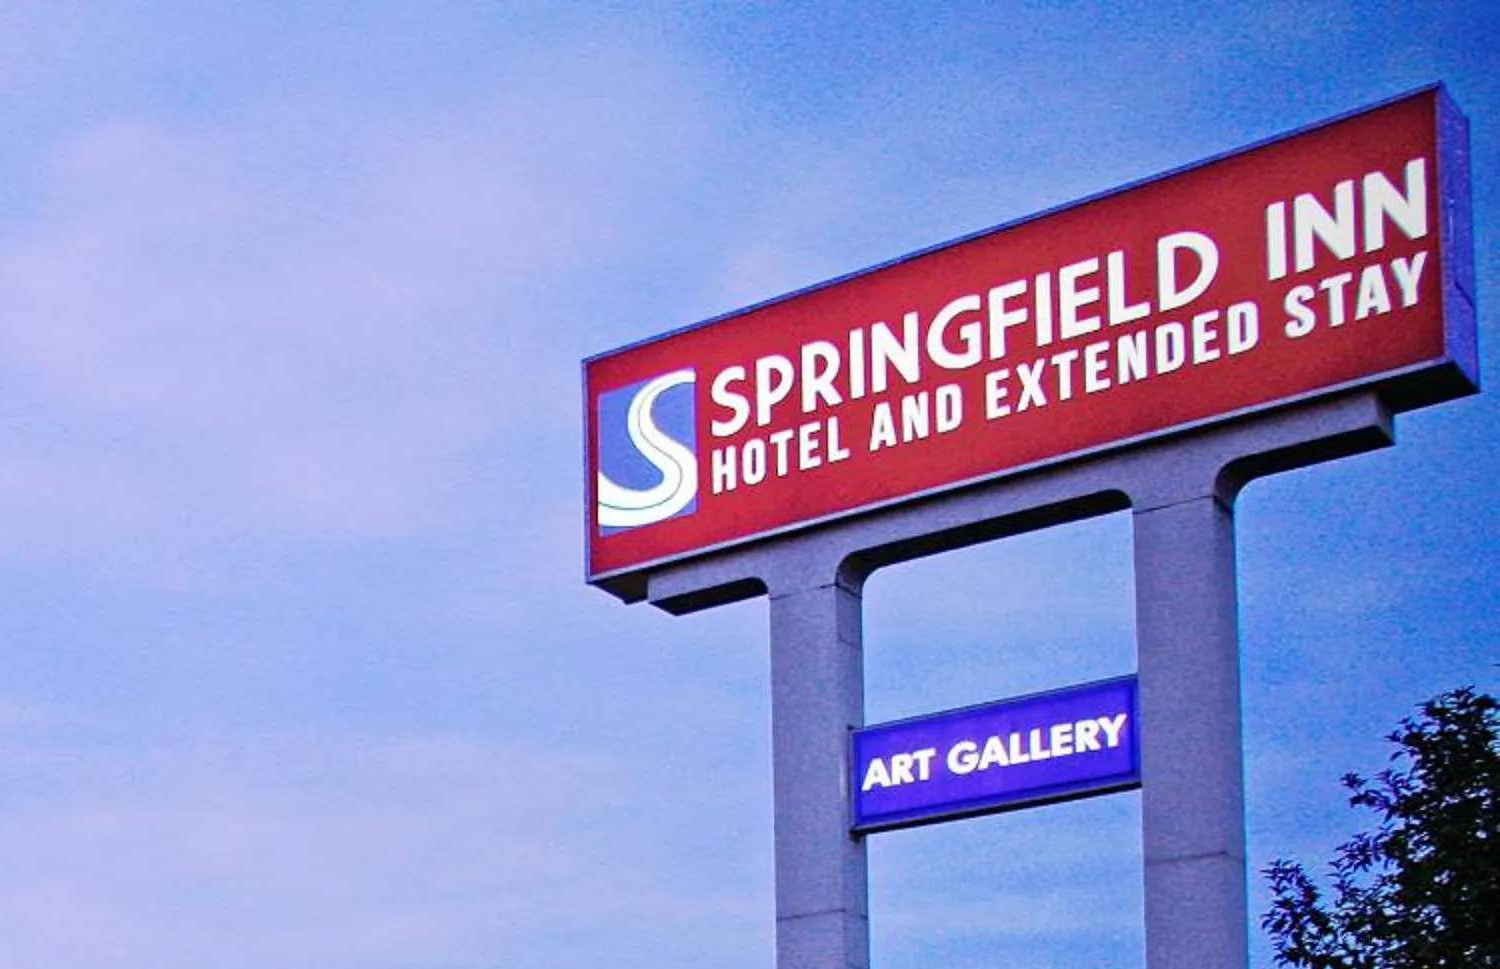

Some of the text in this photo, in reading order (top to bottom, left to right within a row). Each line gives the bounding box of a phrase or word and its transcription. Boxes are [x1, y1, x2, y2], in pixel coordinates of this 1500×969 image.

[710, 158, 1428, 437] SPRINGFIELD INN
[711, 252, 1429, 495] HOTEL AND EXTENDED STAY
[862, 713, 1127, 791] ART GALLERY
